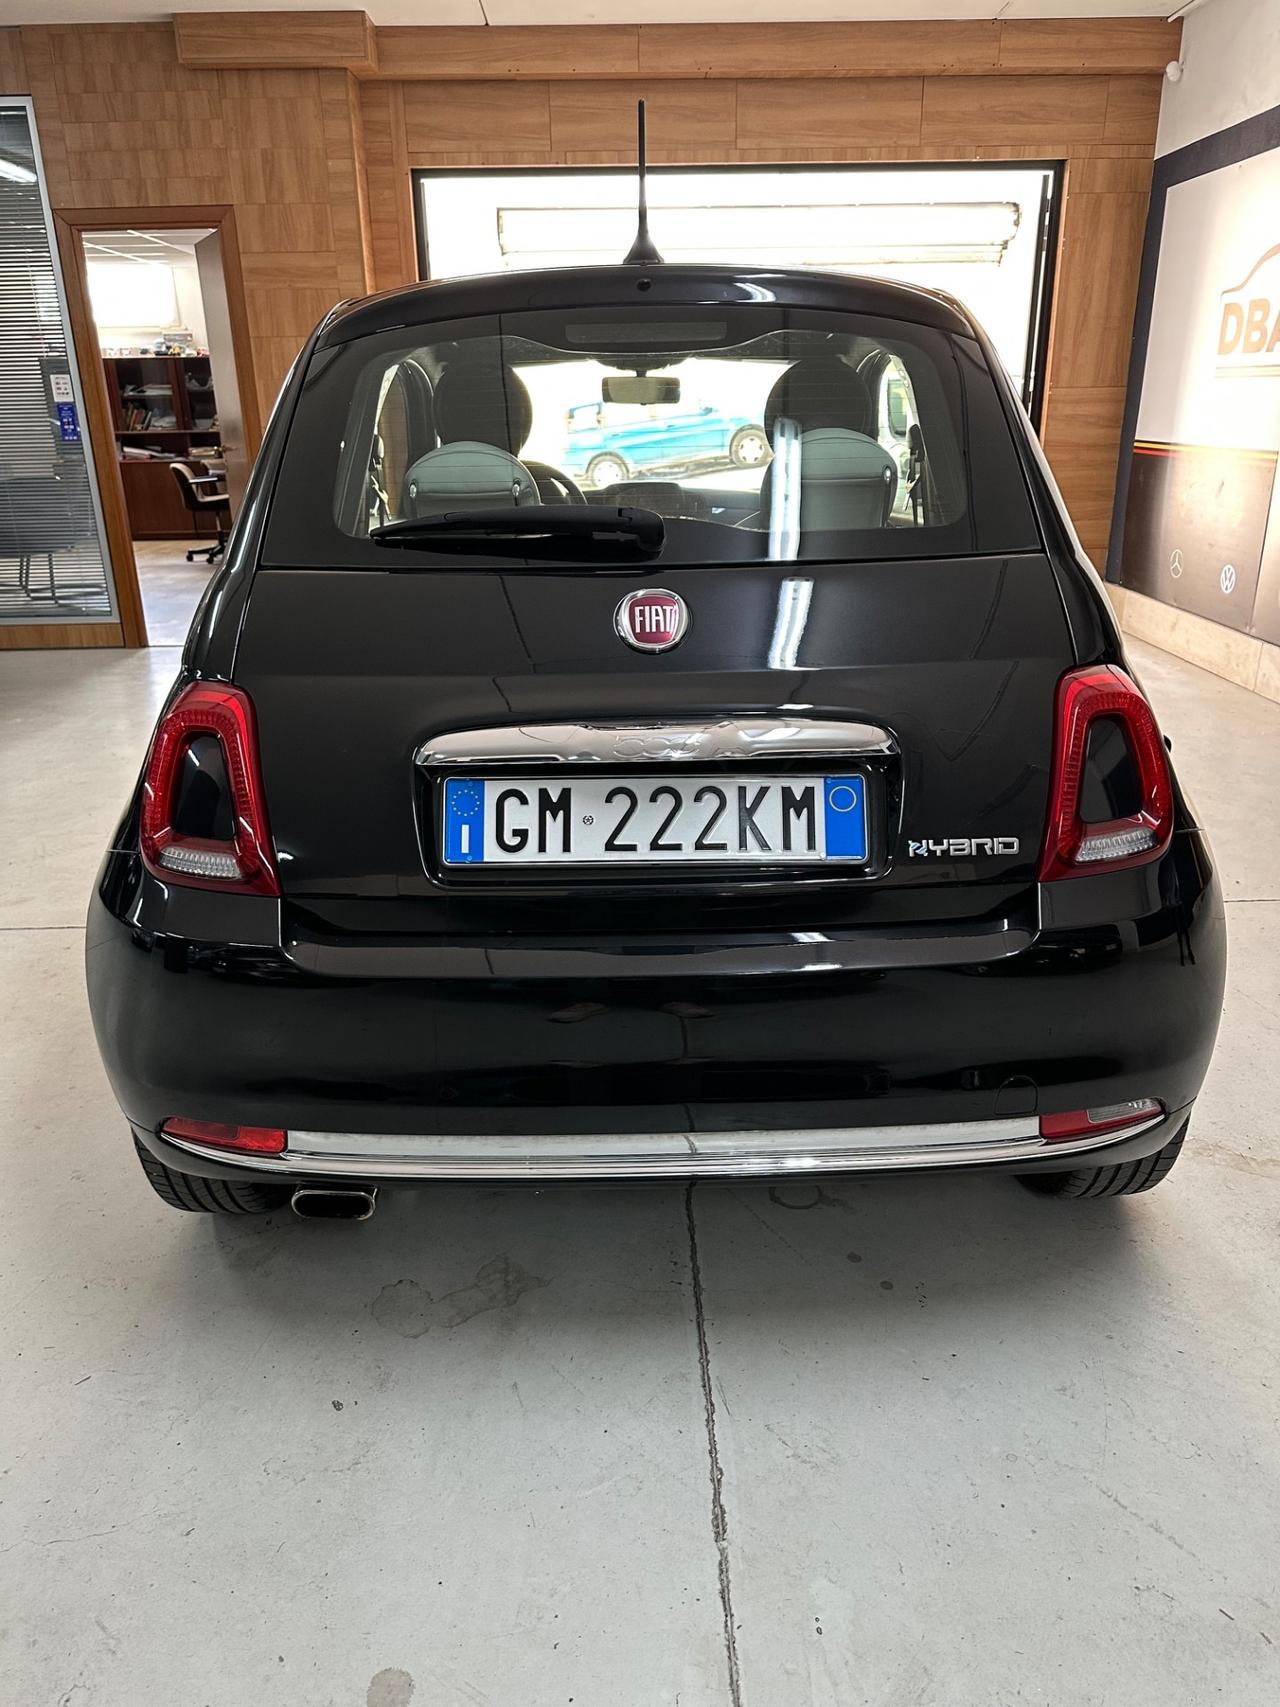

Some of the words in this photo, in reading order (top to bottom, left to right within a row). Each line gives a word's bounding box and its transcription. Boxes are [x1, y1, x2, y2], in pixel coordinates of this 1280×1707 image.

[634, 605, 676, 633] FIAT
[495, 787, 572, 853] GM
[604, 785, 817, 852] 222KM
[908, 837, 1020, 857] HYBRID
